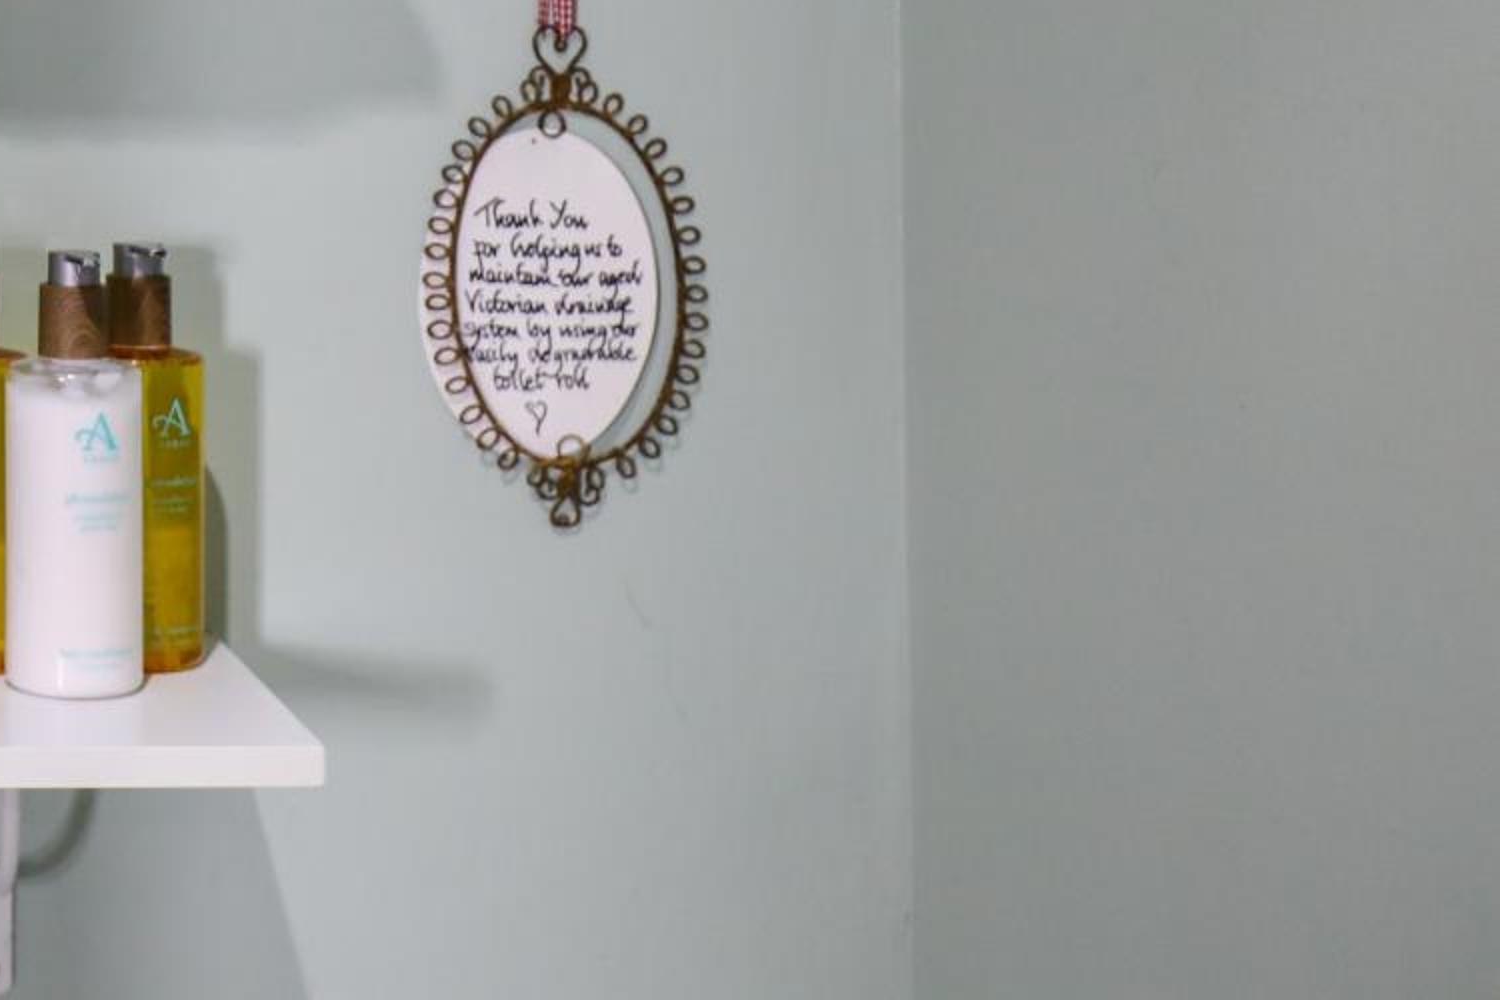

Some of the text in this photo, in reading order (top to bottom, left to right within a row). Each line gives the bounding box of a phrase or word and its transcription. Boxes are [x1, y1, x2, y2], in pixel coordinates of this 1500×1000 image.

[473, 196, 589, 230] Thank You
[510, 231, 580, 274] helping
[584, 243, 601, 258] us
[606, 234, 623, 258] to
[469, 263, 553, 287] maintain
[465, 290, 635, 325] Victorian drainage
[526, 319, 551, 350] by
[559, 323, 607, 347] using
[493, 364, 591, 391] toilet roll
